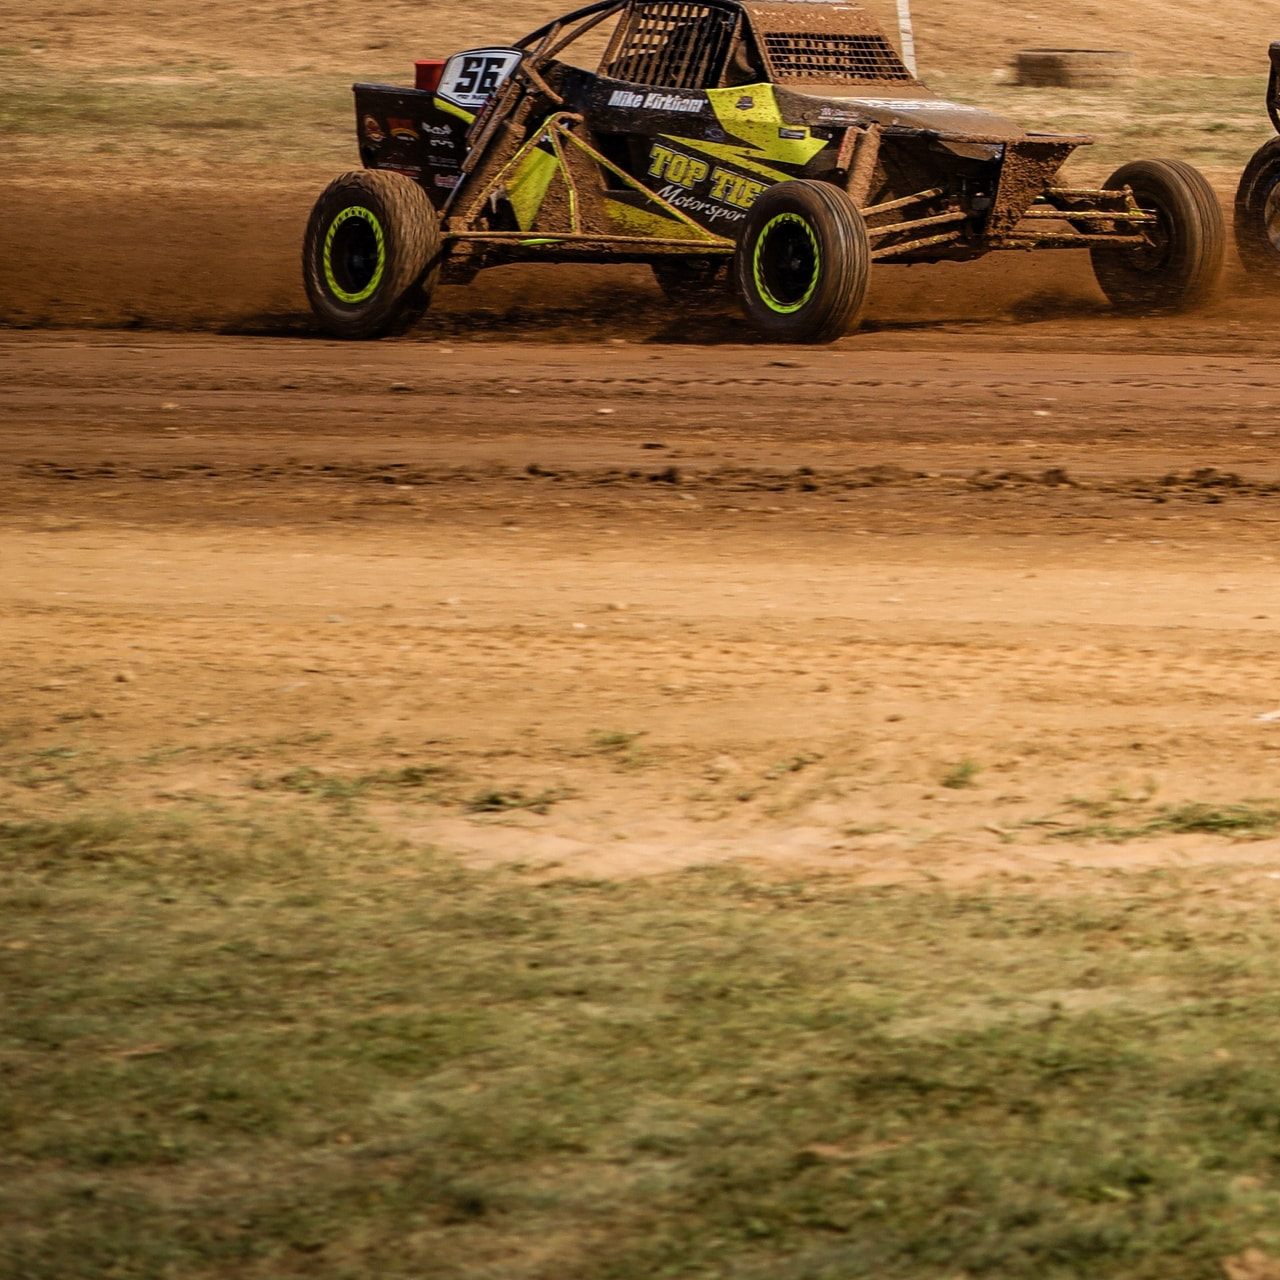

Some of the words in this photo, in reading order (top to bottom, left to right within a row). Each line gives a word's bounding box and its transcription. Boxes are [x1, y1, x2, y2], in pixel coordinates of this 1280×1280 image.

[453, 57, 506, 94] 56
[608, 91, 642, 108] Mike
[643, 93, 704, 112] Kirkham
[649, 144, 709, 190] TOP
[709, 167, 771, 212] TIE
[656, 184, 746, 222] Motorspor
